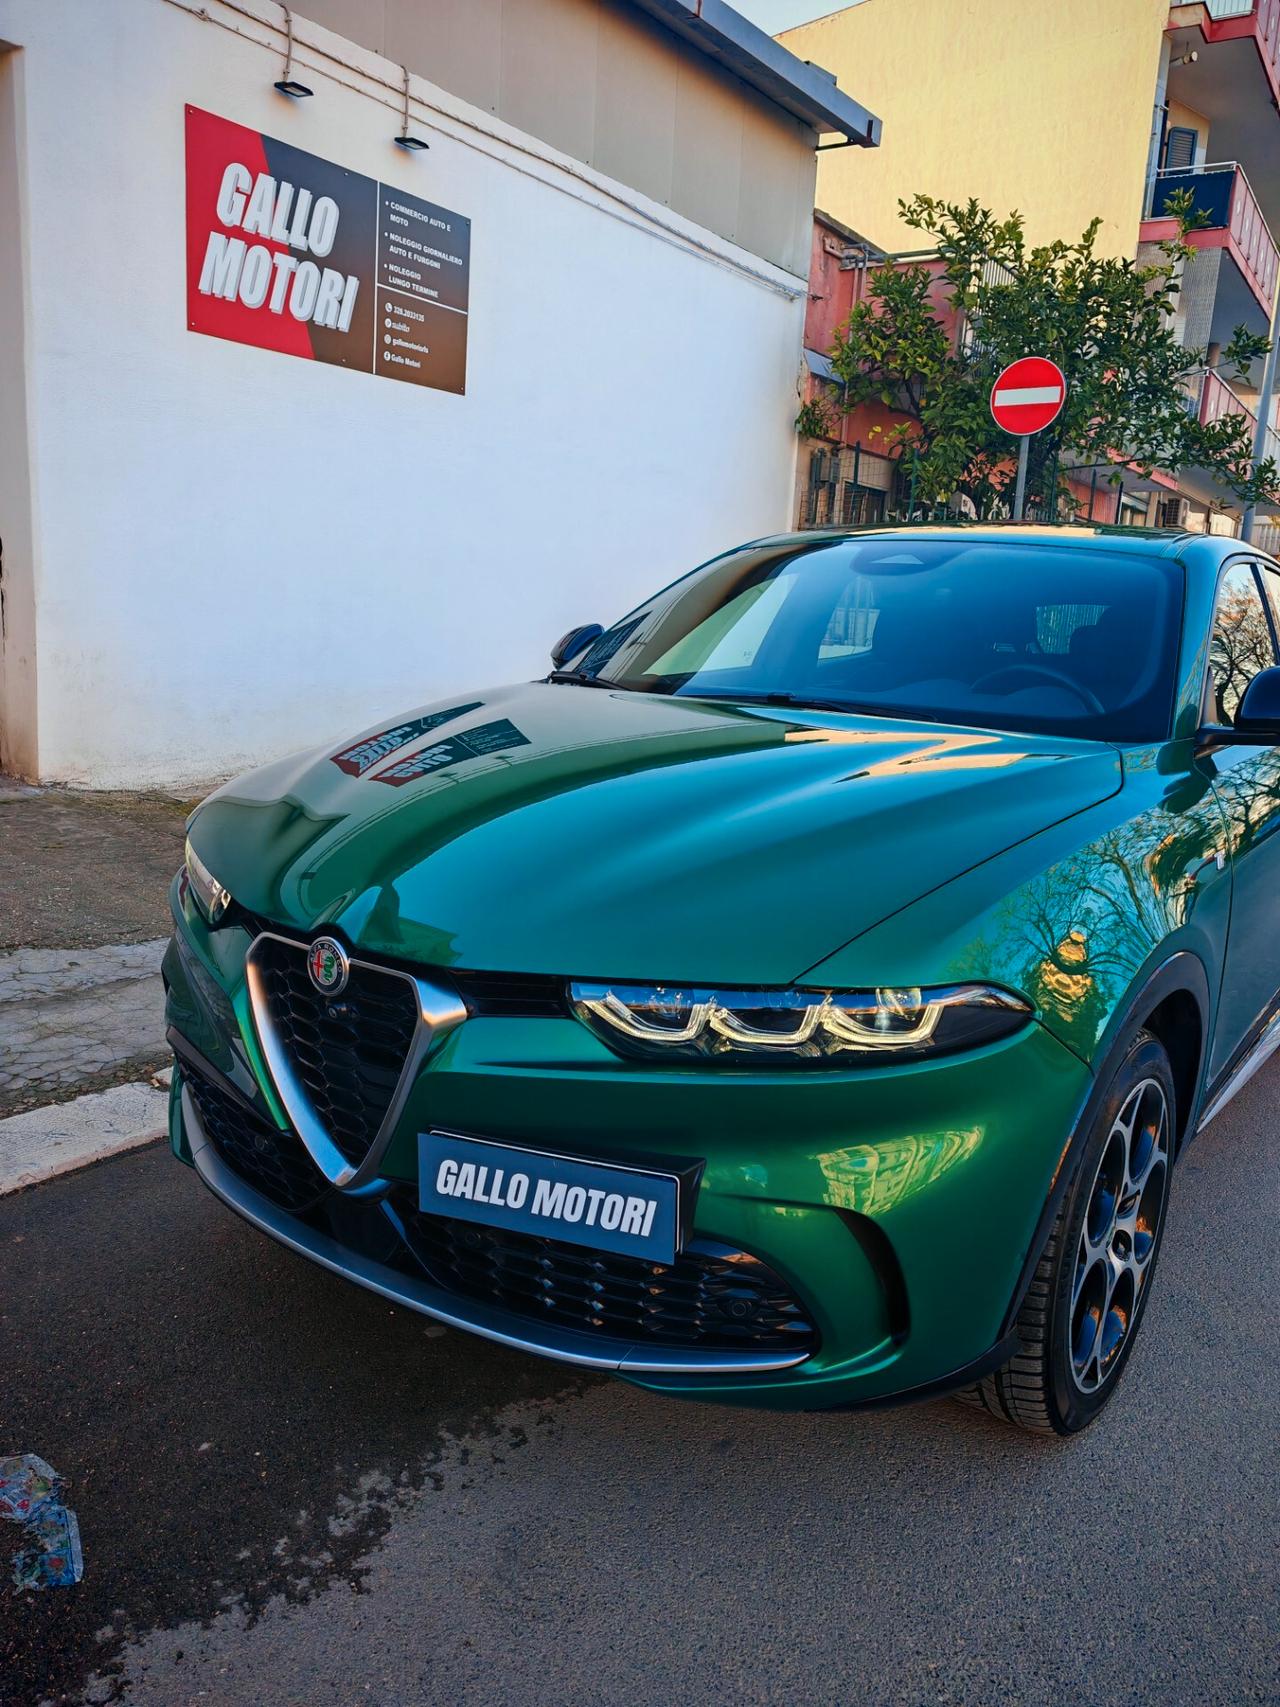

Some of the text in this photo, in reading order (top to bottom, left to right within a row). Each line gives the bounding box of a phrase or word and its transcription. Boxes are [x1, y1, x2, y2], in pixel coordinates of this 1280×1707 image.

[216, 162, 340, 258] GALLO
[390, 201, 451, 232] COMMERCIO AUTO E
[390, 213, 409, 227] MOTO
[389, 232, 463, 266] NOLEGGIO GIORNALIERO
[389, 245, 441, 269] AUTO E FURGONI
[198, 230, 360, 333] MOTORI
[388, 263, 422, 280] NOLEGGIO
[388, 275, 439, 299] LUNGO TERMINE
[436, 1159, 658, 1238] GALLO MOTORI
